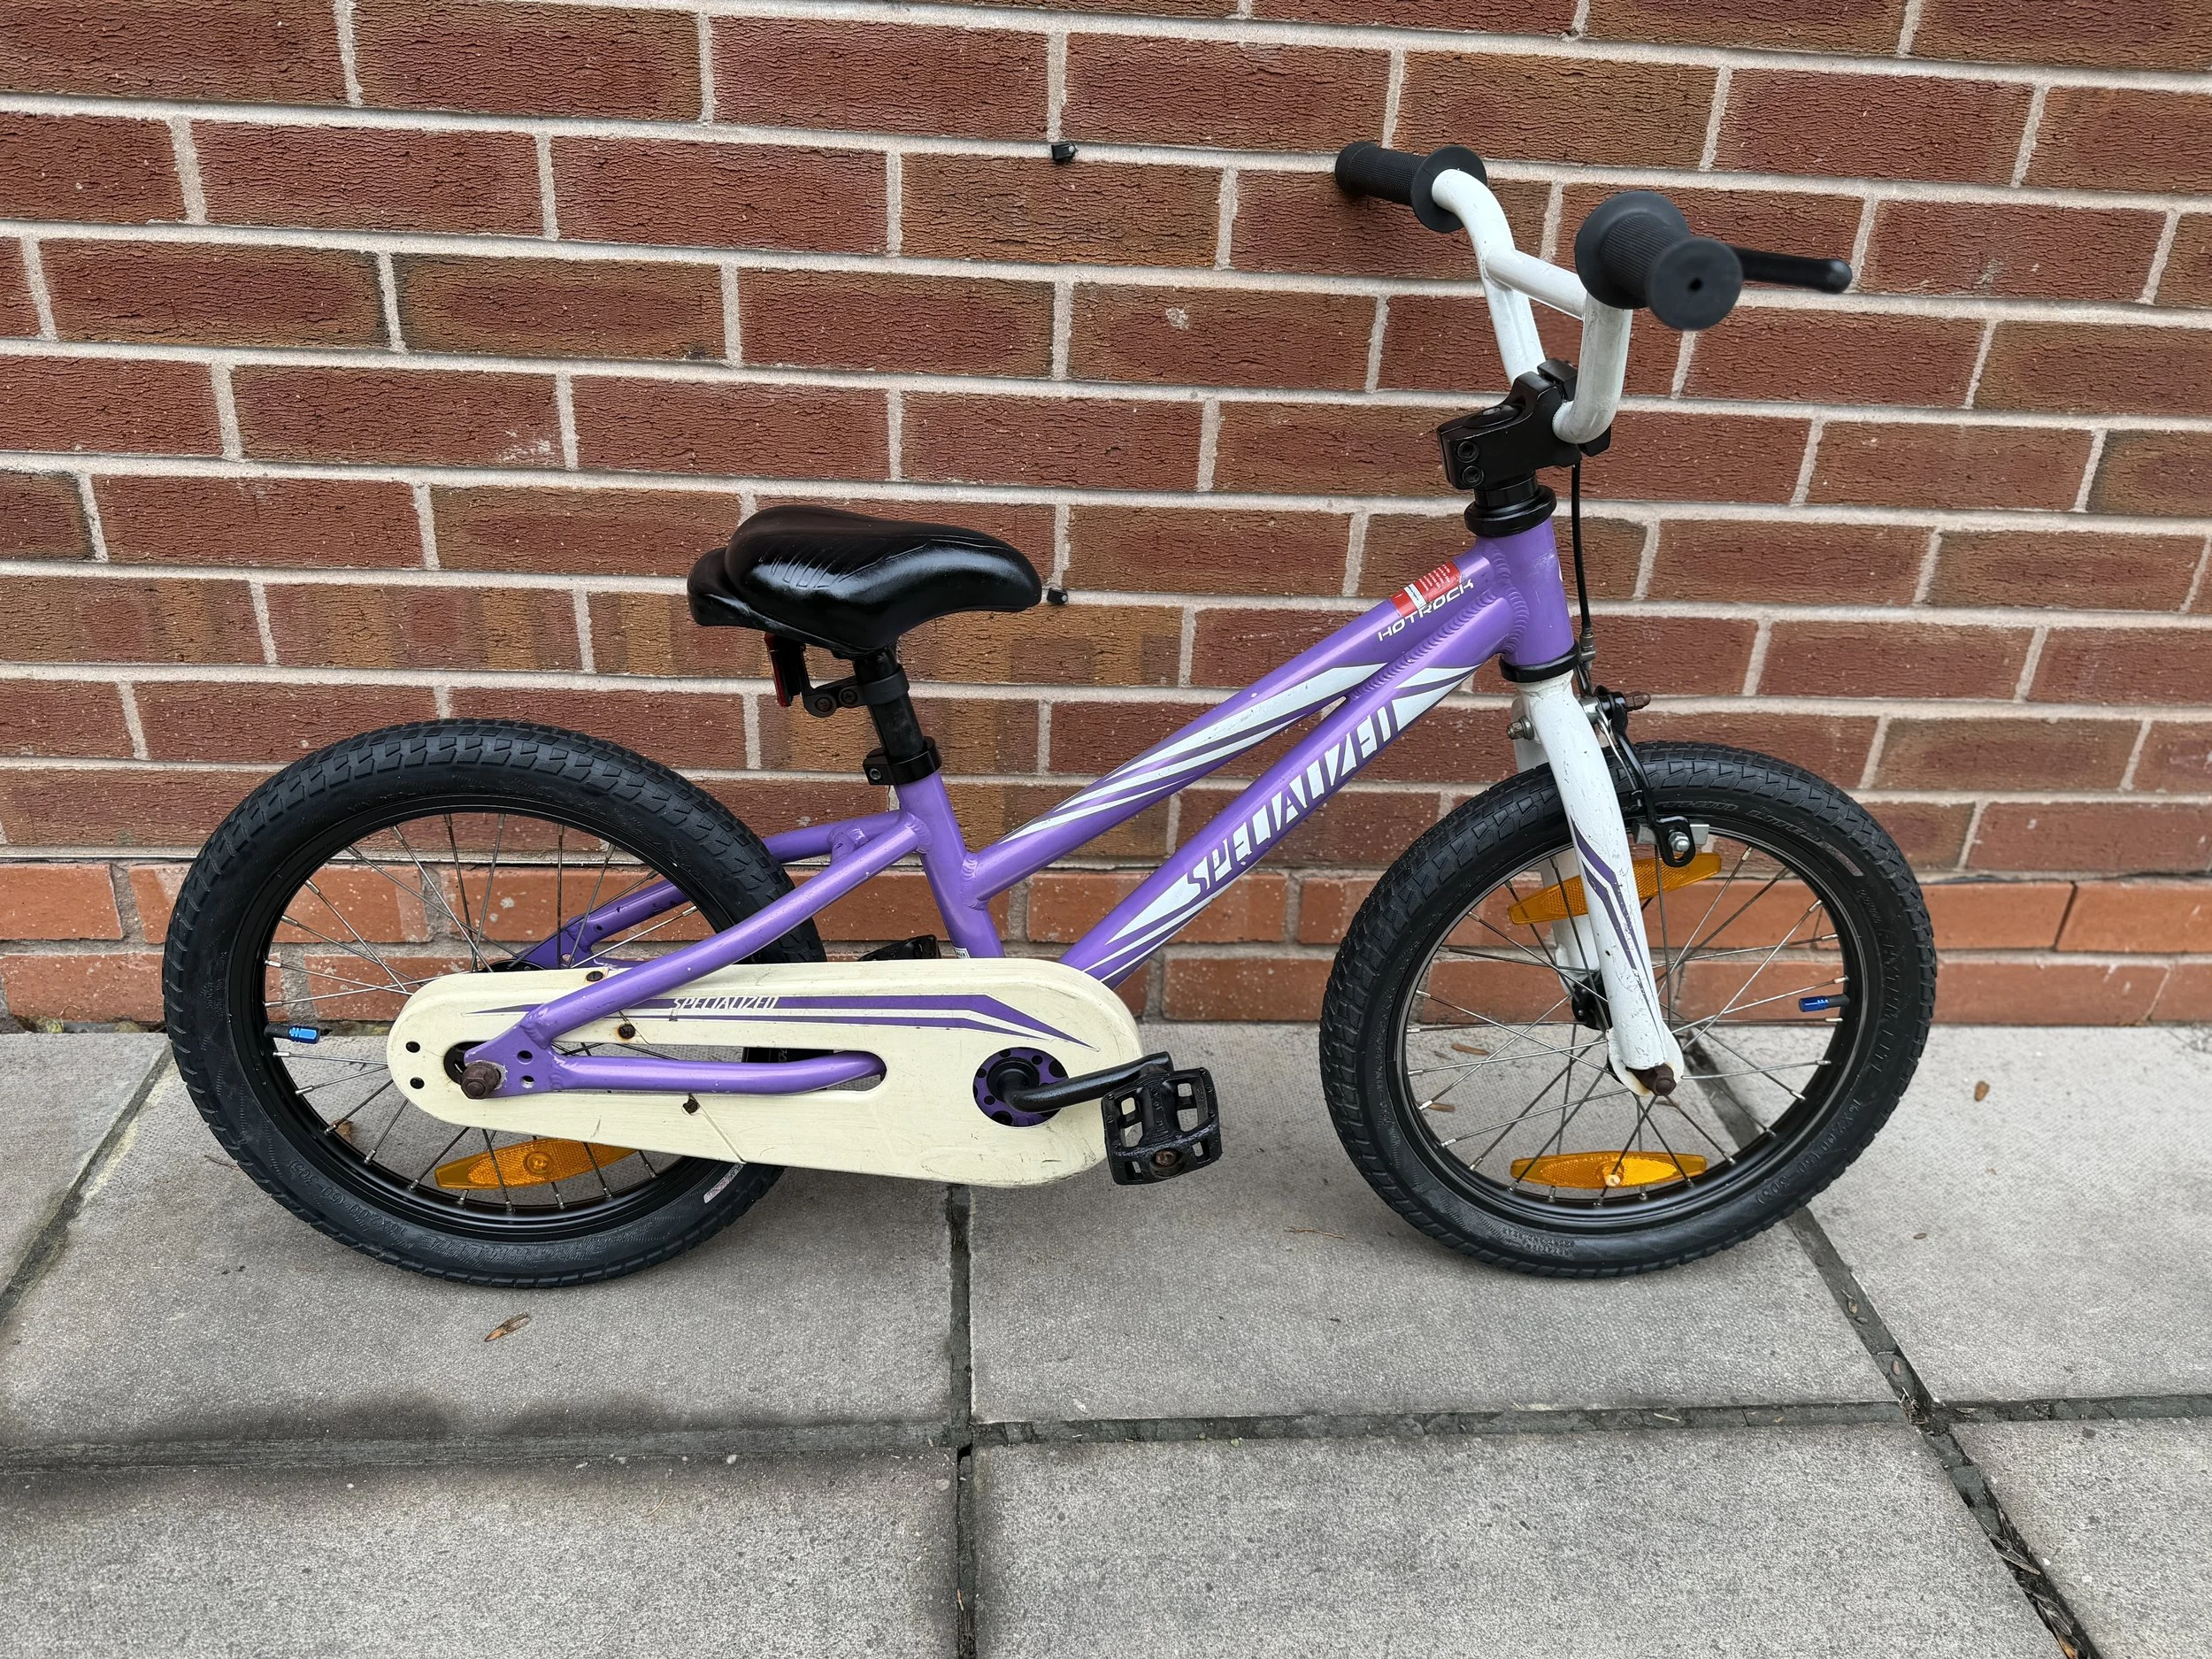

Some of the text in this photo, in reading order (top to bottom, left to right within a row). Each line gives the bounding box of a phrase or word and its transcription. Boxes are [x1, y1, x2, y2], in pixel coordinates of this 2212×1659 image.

[1378, 579, 1475, 641] HOTROCK
[1186, 699, 1398, 895] SPECIALIZED
[670, 996, 780, 1010] SPECIALIZED
